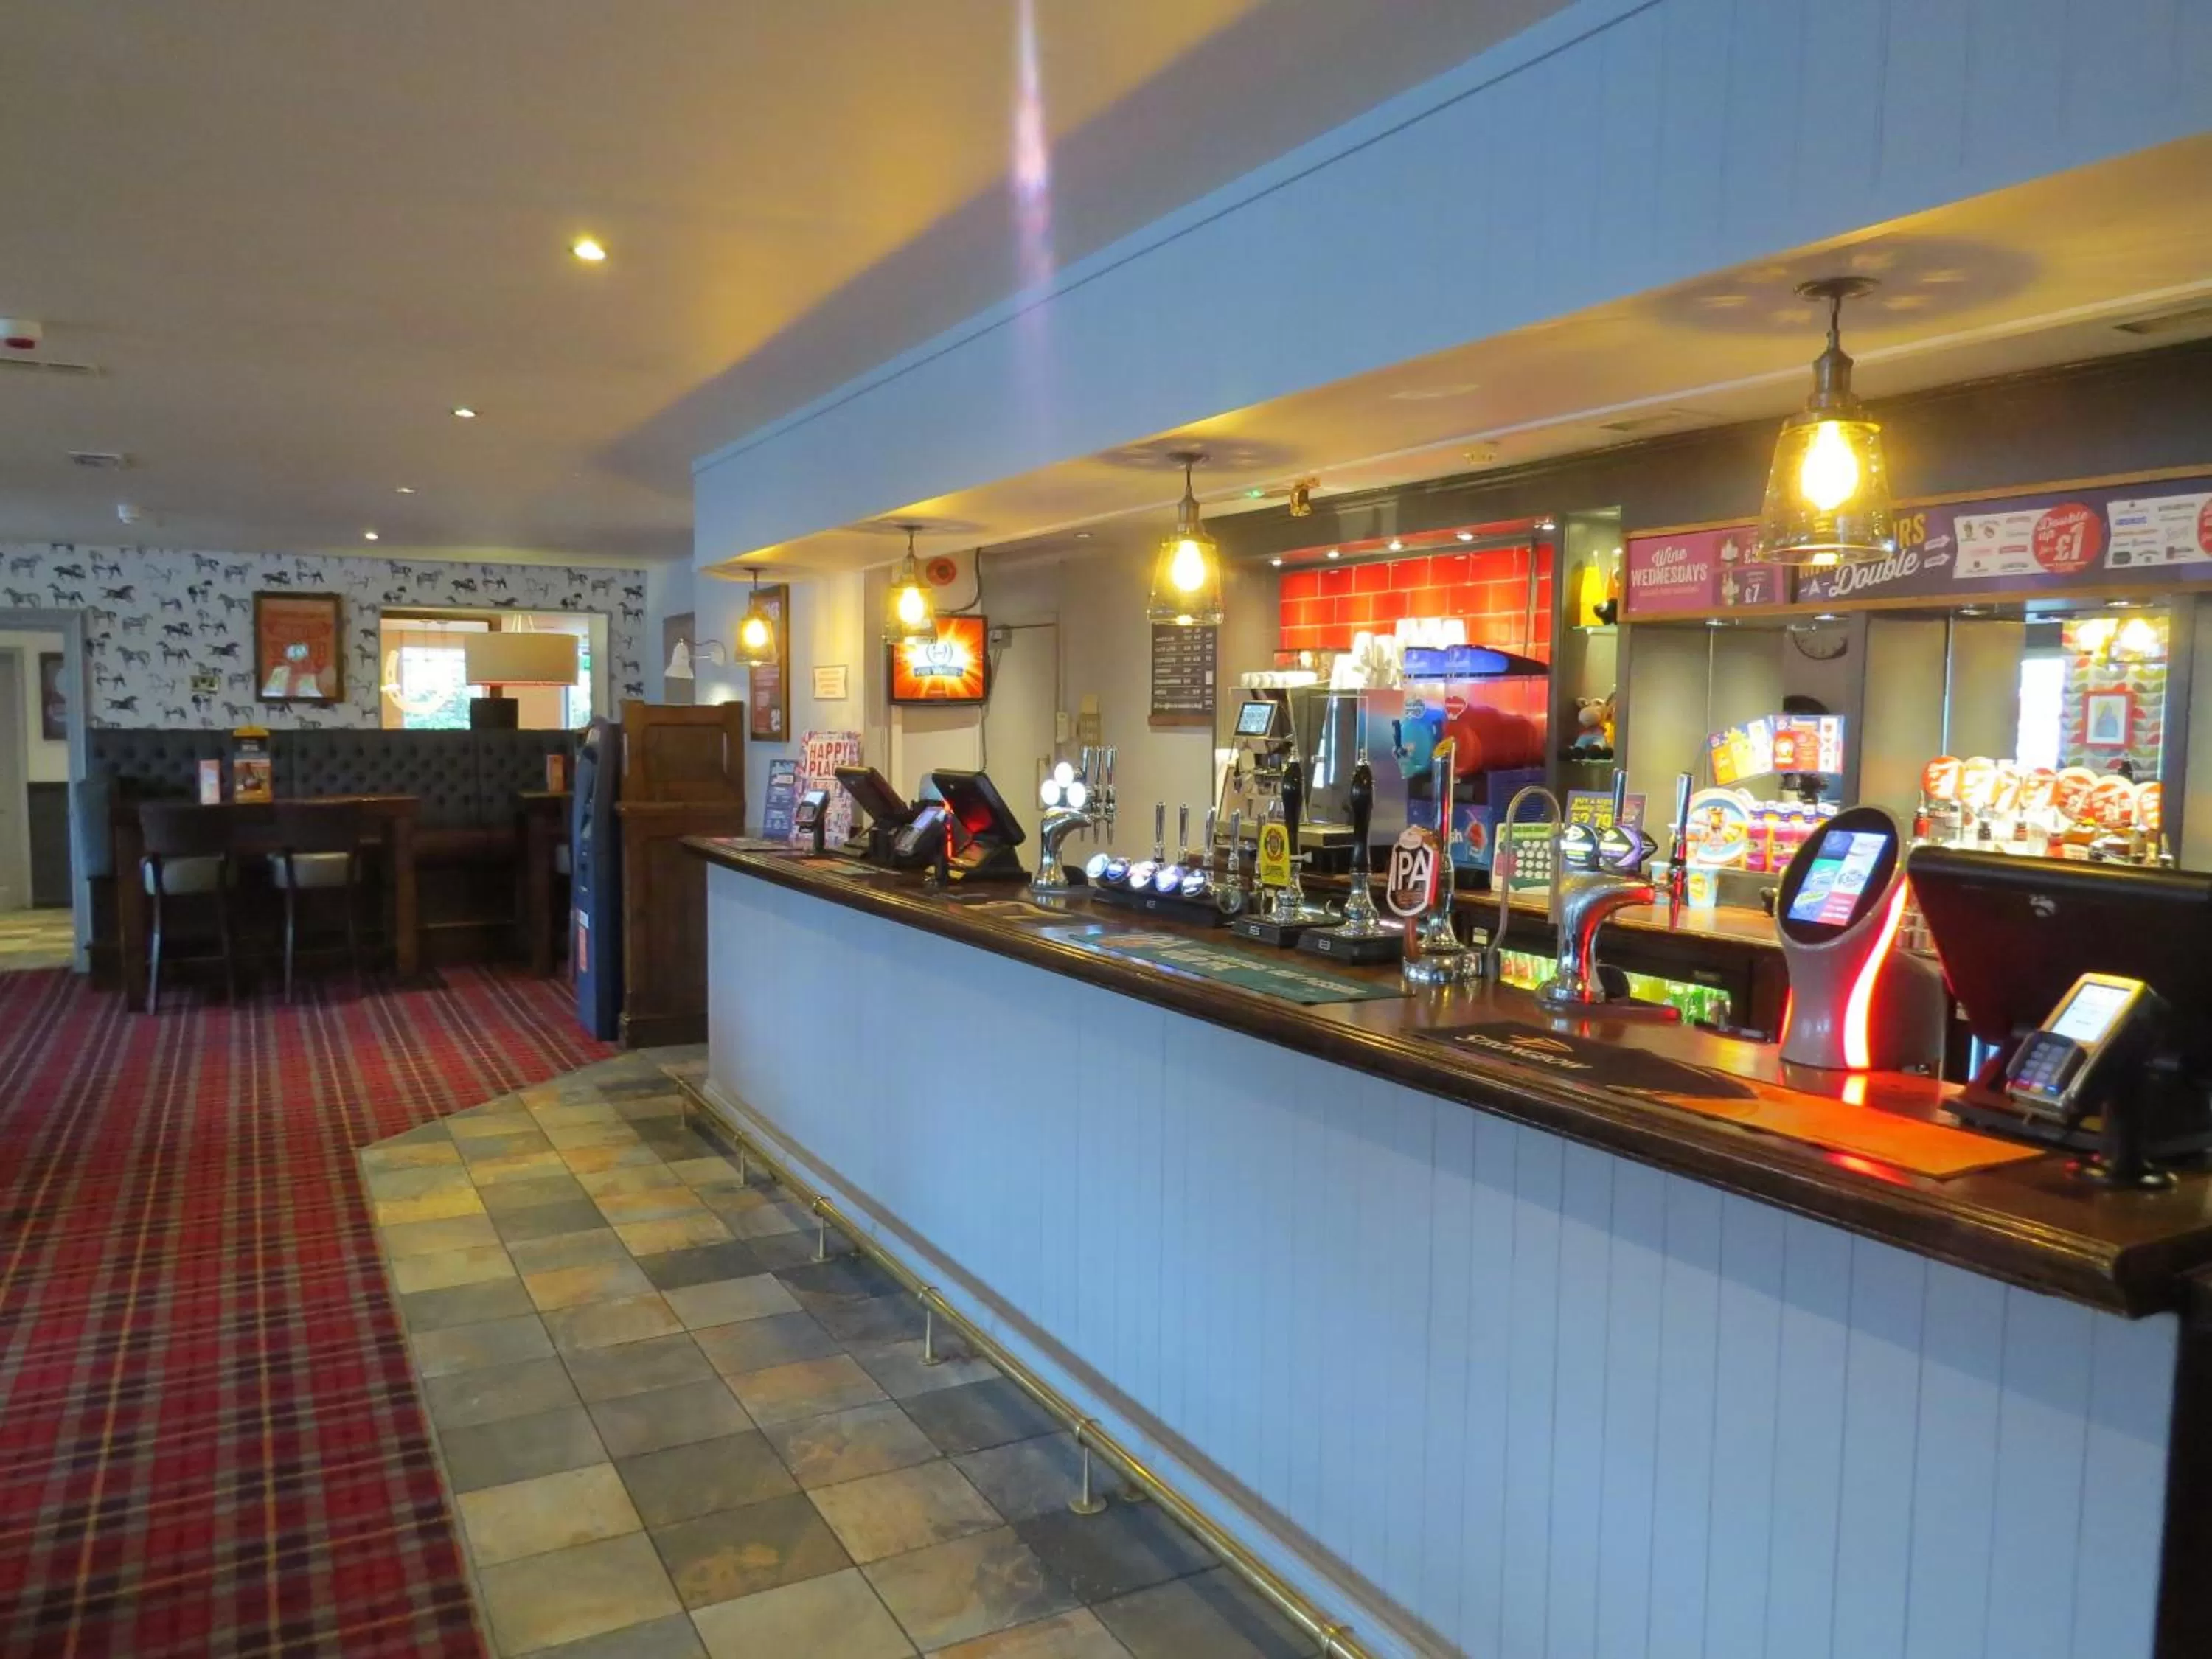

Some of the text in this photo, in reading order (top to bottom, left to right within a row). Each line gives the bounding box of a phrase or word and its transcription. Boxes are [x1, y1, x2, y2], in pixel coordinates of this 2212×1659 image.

[1652, 546, 1687, 566] Wine
[2053, 521, 2086, 561] £1
[1631, 563, 1708, 588] WEDNESDAYS
[1828, 548, 1921, 598] Double
[810, 742, 848, 759] HAPPY
[1391, 848, 1430, 891] IPA
